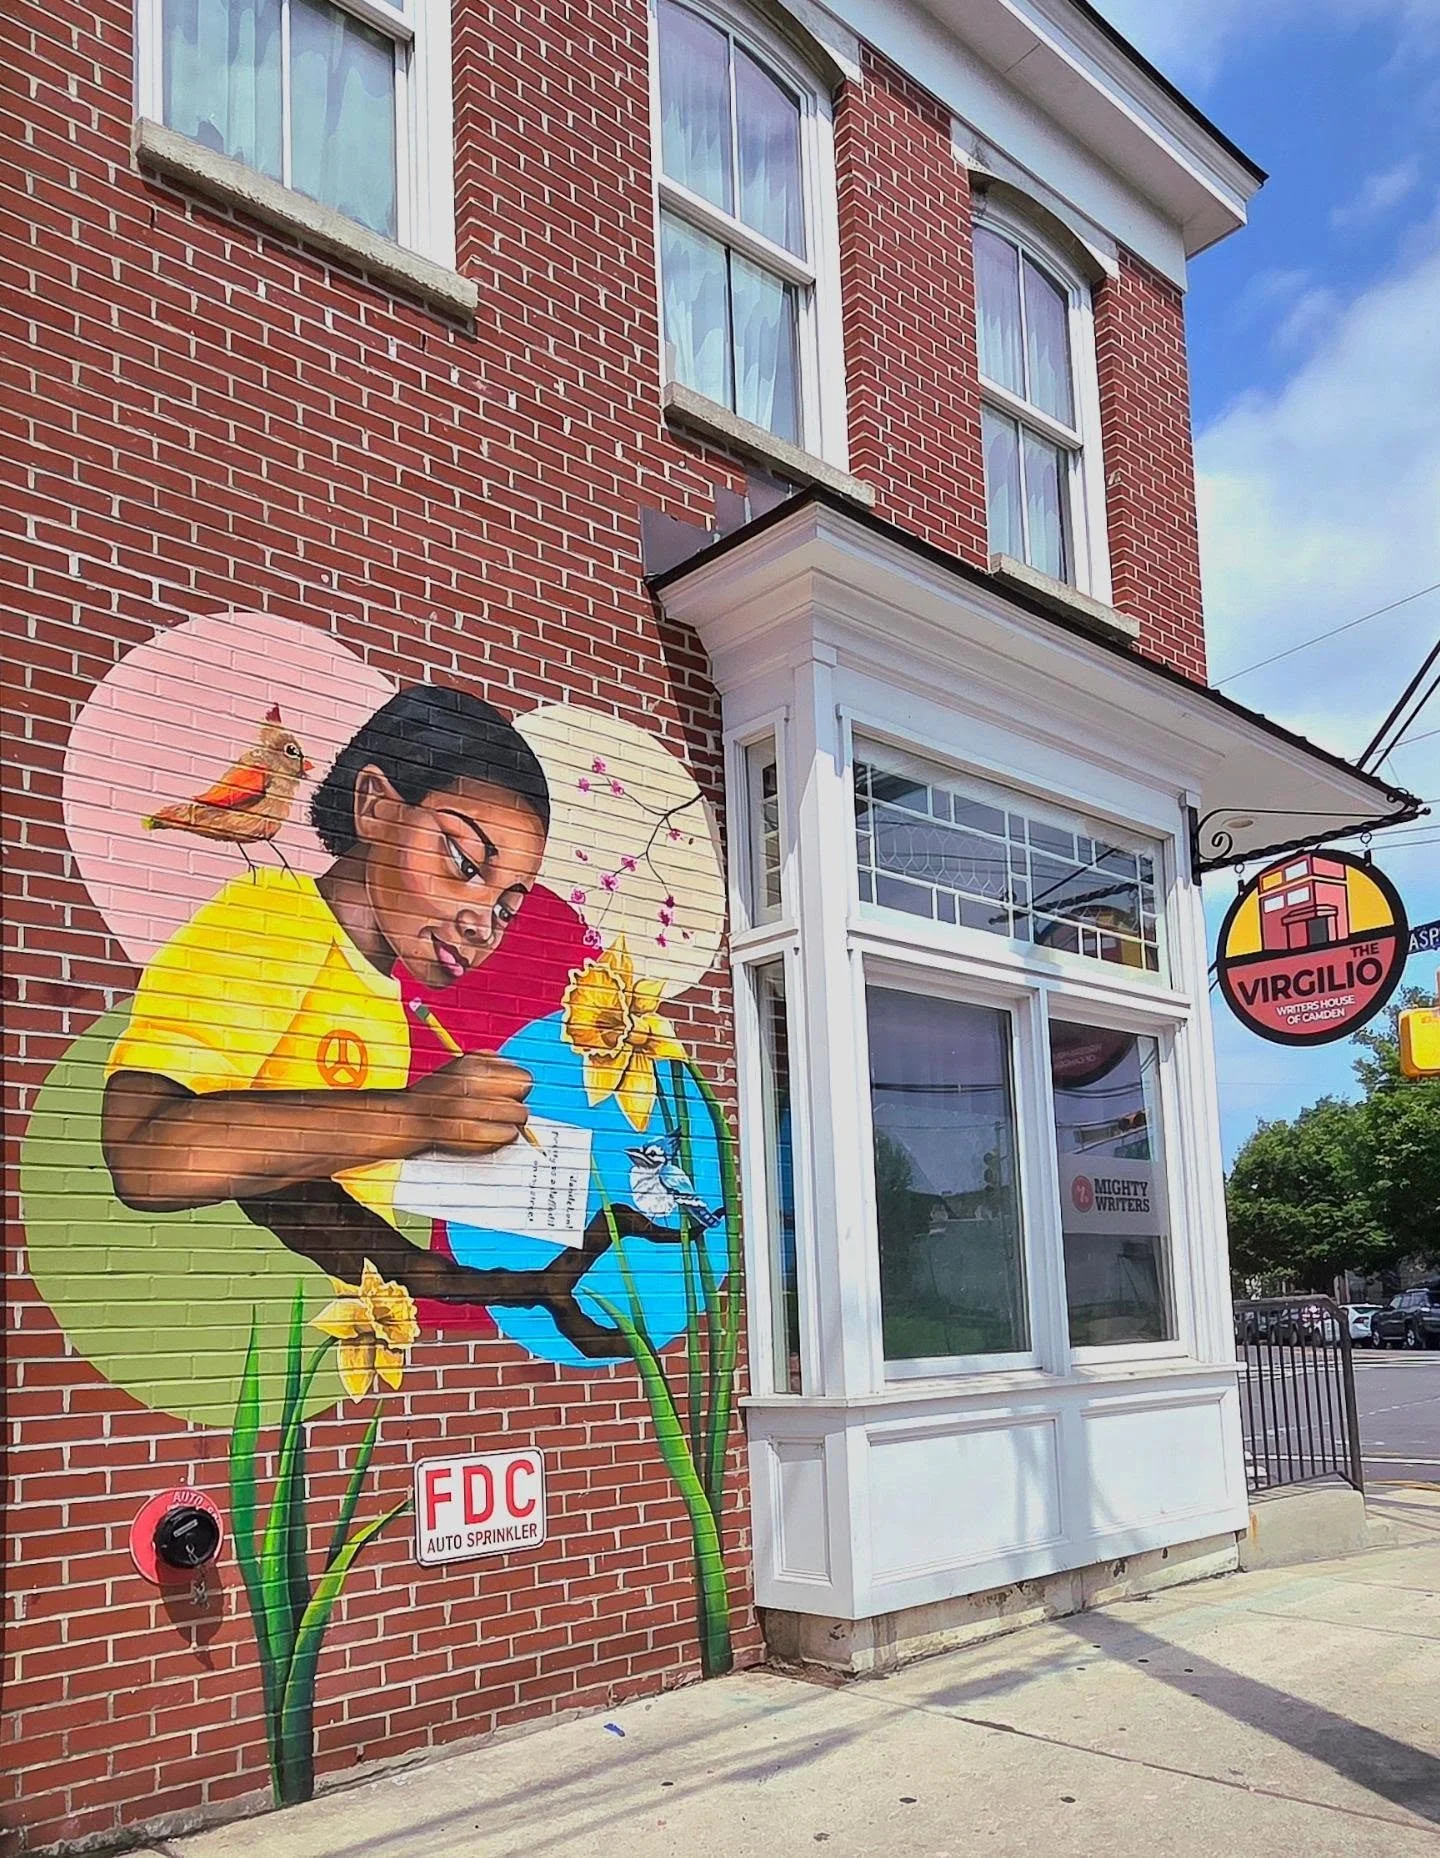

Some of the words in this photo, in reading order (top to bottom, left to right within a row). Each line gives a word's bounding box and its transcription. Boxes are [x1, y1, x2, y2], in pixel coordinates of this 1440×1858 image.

[1350, 942, 1380, 958] THE
[1238, 957, 1383, 1006] VIRGILIO
[1276, 1000, 1320, 1016] WRITERS
[1320, 995, 1356, 1009] HOUSE
[1287, 1015, 1302, 1025] OF
[1302, 1008, 1346, 1023] CAMDEN
[1094, 1178, 1148, 1197] MIGHTY
[1095, 1196, 1150, 1213] WRITERS
[172, 1491, 204, 1505] AUTO
[425, 1459, 536, 1531] FDC
[427, 1534, 462, 1554] AUTO
[467, 1523, 538, 1547] SPRINKLER
